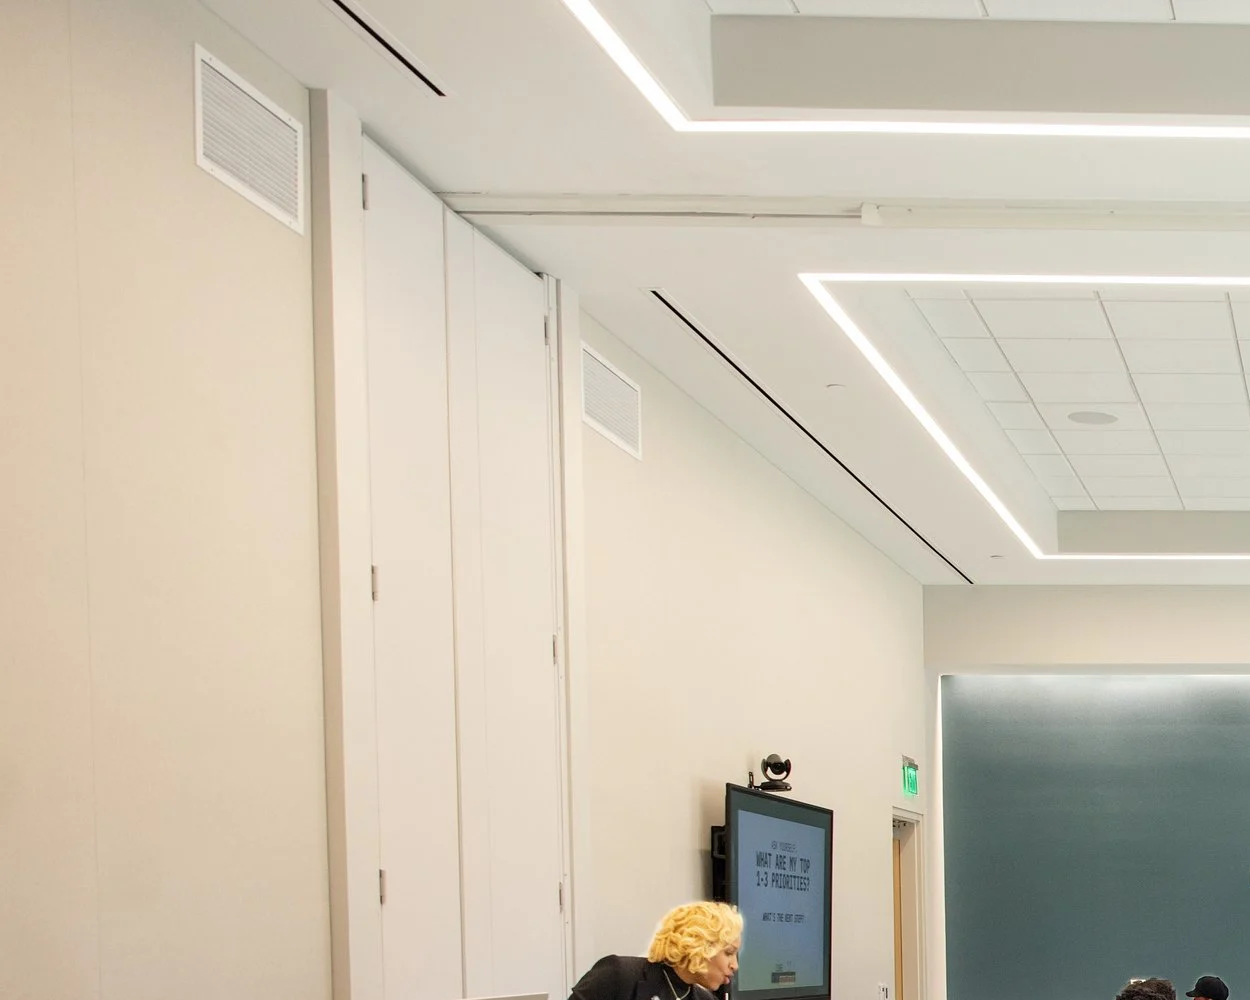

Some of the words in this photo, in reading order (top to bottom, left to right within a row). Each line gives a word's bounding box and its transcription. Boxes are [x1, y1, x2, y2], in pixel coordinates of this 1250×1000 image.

[756, 851, 772, 868] WHAT
[775, 854, 786, 871] ARE
[789, 857, 797, 872] MY
[799, 858, 811, 874] TOP
[756, 870, 768, 888] 1-3
[771, 872, 810, 892] PRIORITIES?
